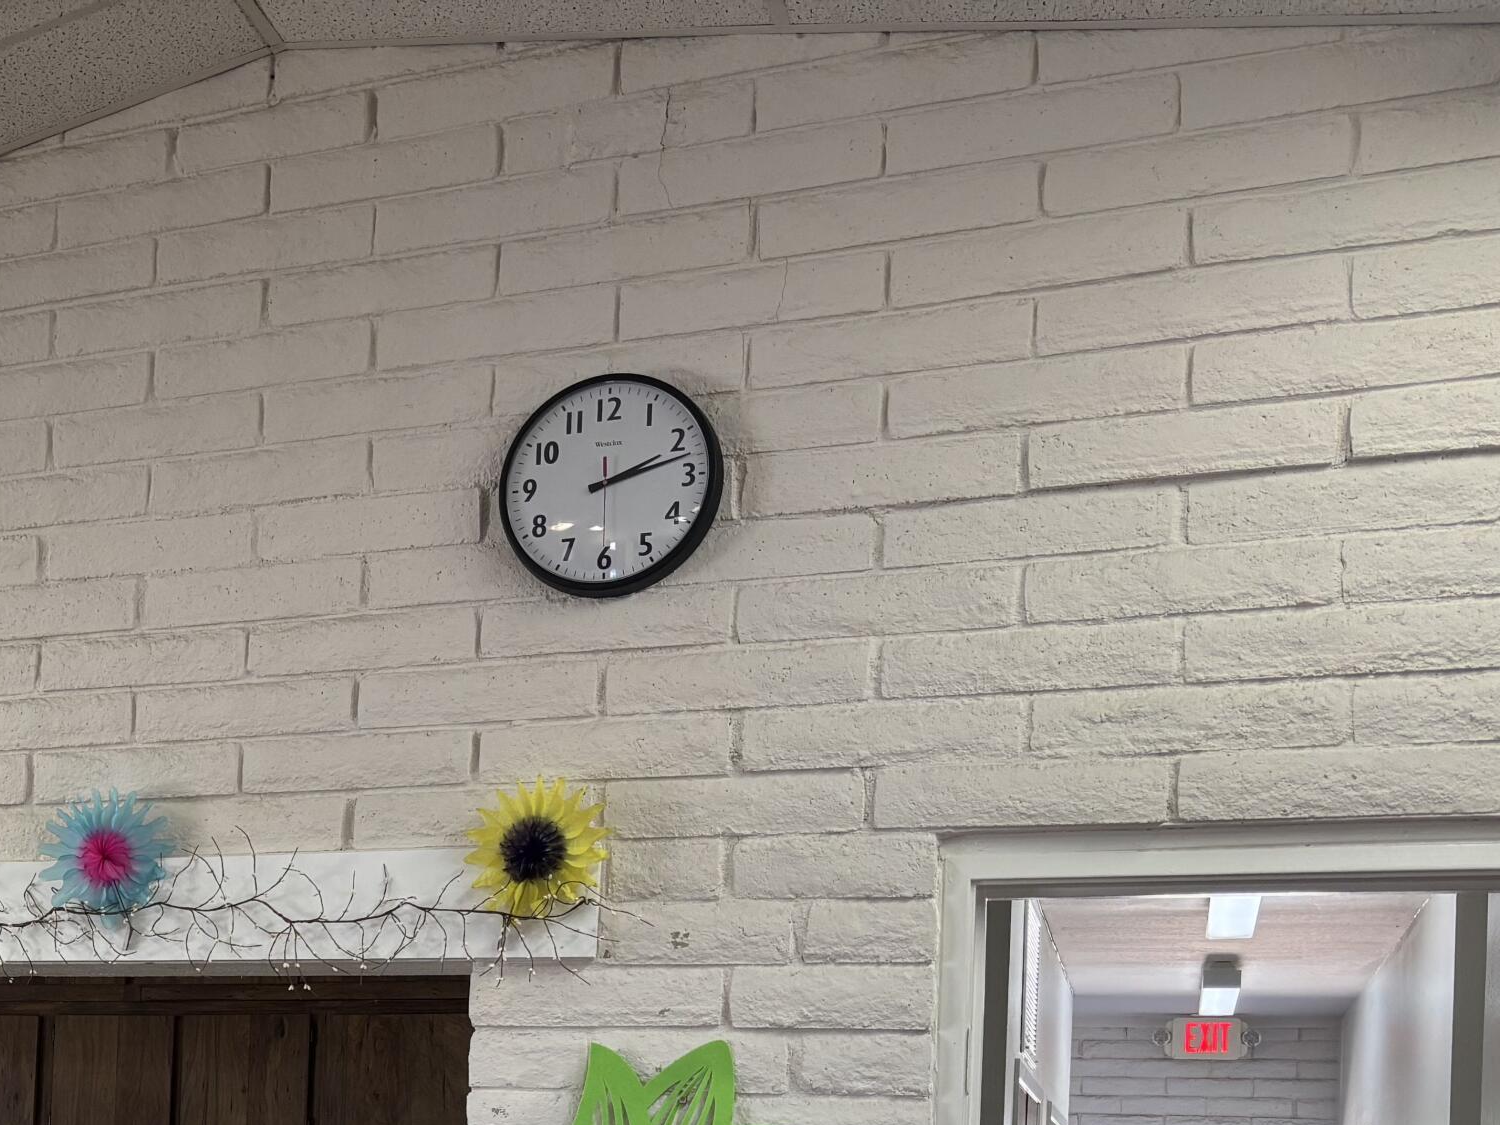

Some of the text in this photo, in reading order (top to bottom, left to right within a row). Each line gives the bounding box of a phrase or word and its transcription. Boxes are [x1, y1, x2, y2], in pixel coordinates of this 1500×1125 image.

[596, 397, 622, 422] 12
[646, 403, 653, 427] 1
[566, 410, 583, 434] 11
[670, 428, 685, 451] 2
[535, 441, 559, 465] 10
[681, 463, 696, 487] 3
[522, 479, 537, 502] 9
[665, 501, 680, 525] 4
[532, 514, 547, 538] 8
[561, 538, 575, 561] 7
[638, 532, 653, 556] 5
[597, 546, 612, 570] 6
[1185, 1021, 1233, 1054] EXIT
